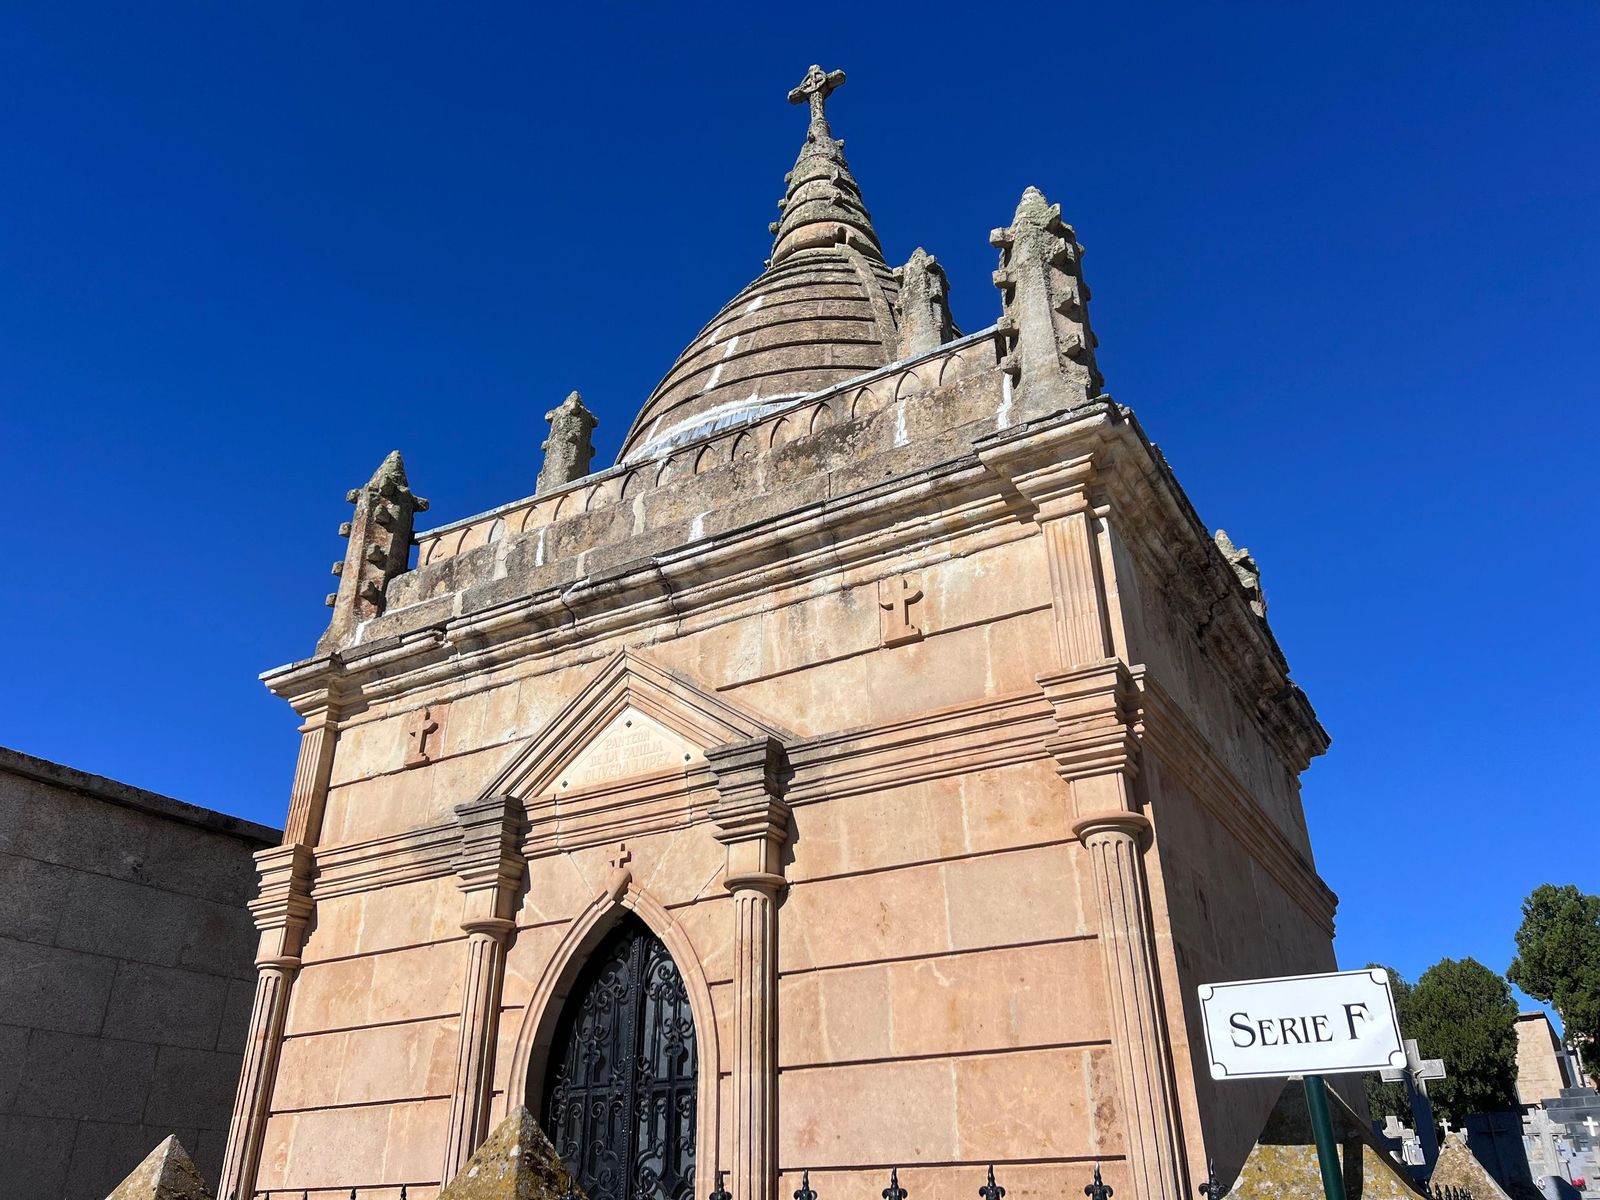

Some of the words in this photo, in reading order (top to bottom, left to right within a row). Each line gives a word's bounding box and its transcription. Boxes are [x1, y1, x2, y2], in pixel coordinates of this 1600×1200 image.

[590, 753, 602, 767] DE
[606, 750, 619, 764] LA
[623, 741, 664, 759] FAMILIA
[584, 759, 630, 782] OLIVERA
[1229, 1012, 1334, 1048] SERIE
[1342, 1002, 1369, 1040] F
